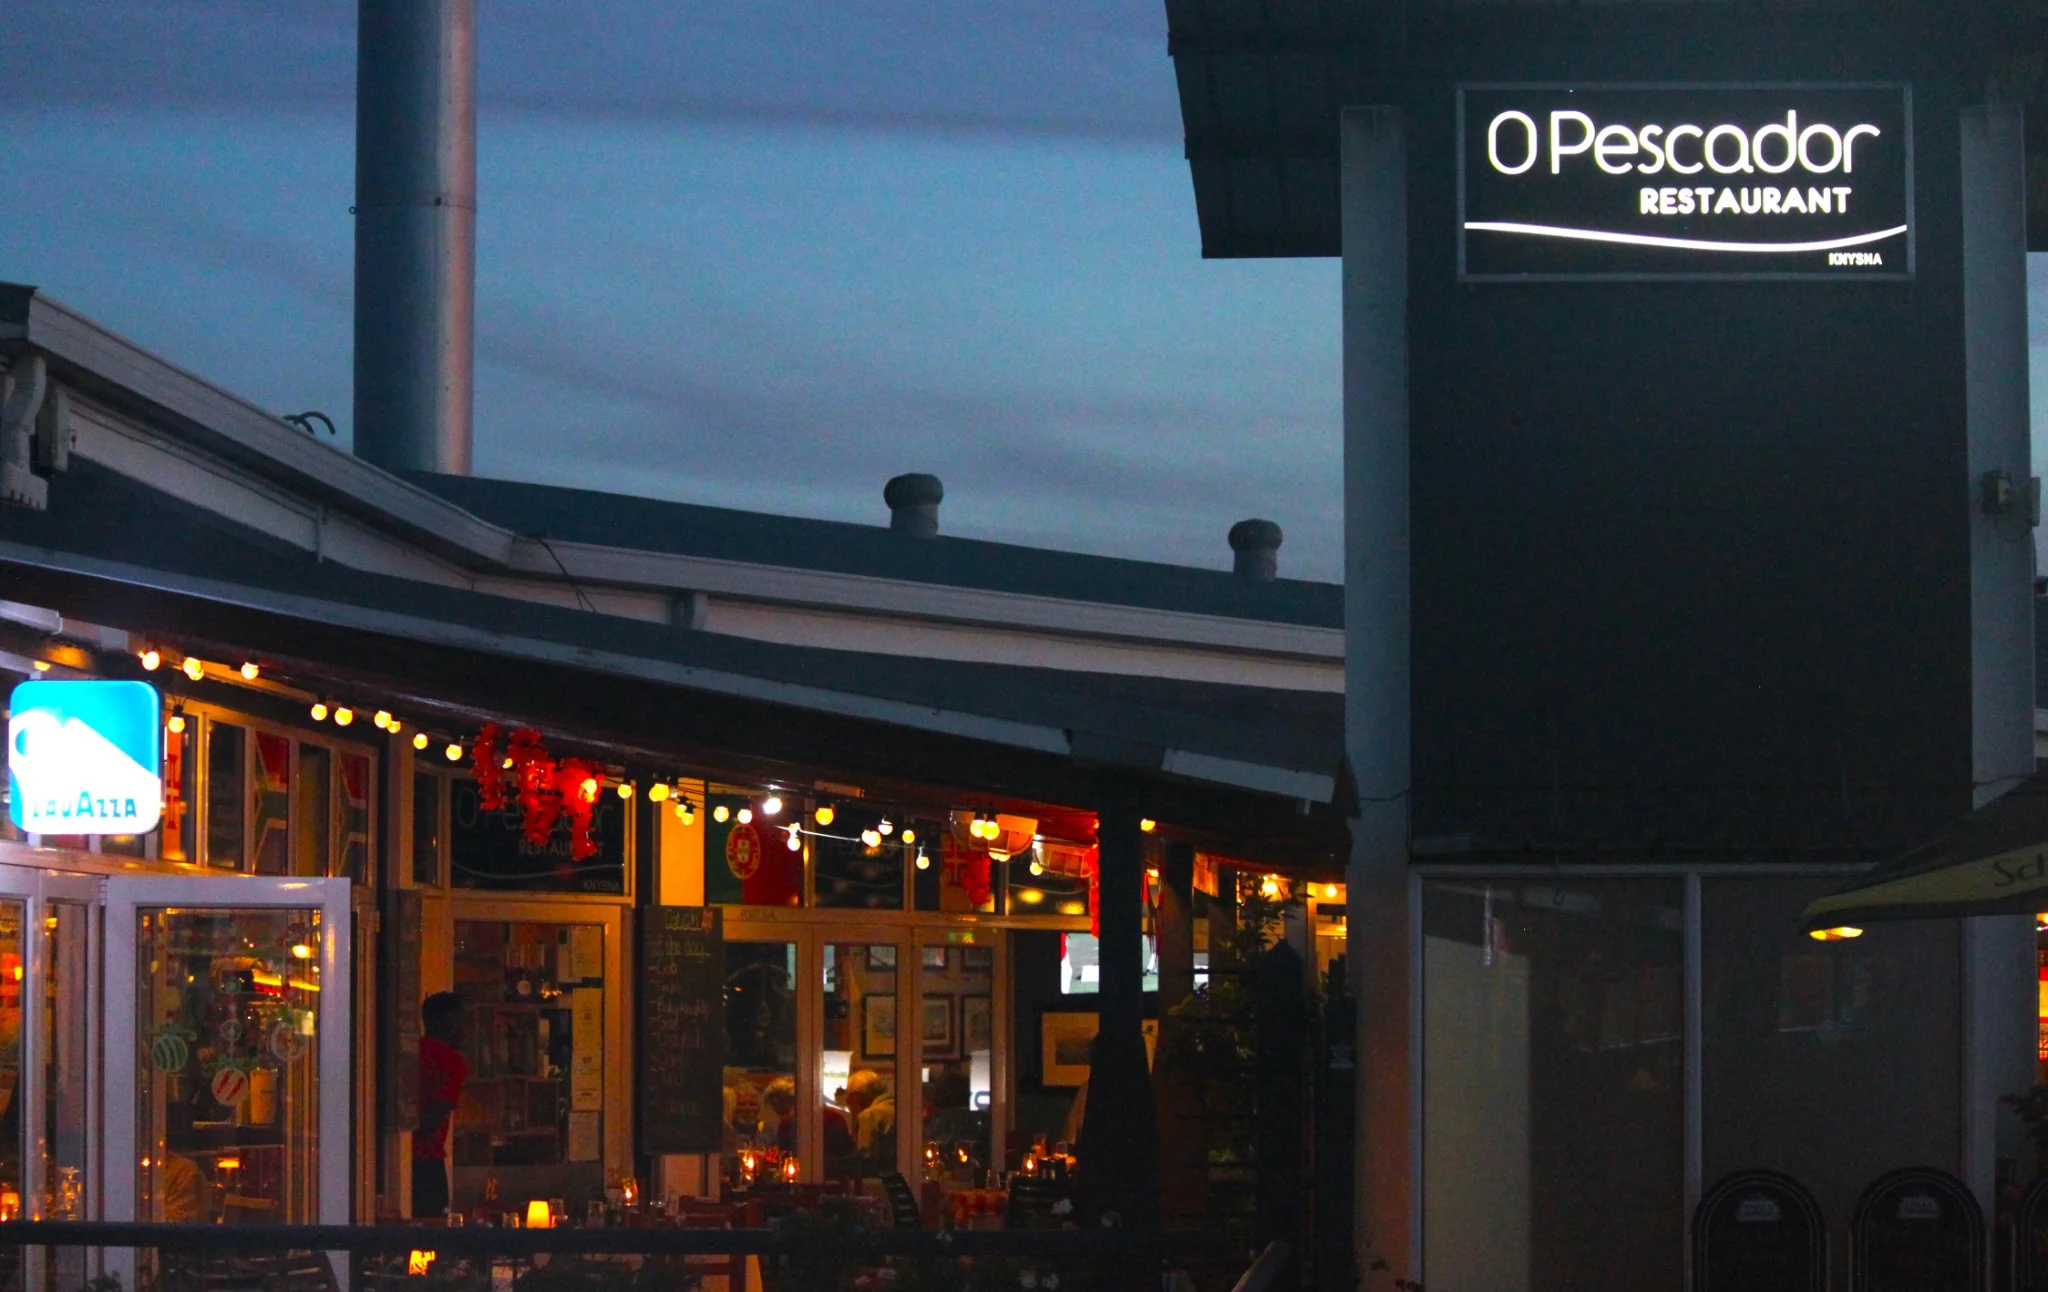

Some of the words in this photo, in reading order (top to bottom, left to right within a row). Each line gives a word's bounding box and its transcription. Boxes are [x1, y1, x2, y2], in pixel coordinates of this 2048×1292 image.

[1488, 110, 1537, 175] O
[1551, 109, 1881, 175] Pescador
[1640, 187, 1852, 214] RESTAURANT
[1829, 253, 1882, 265] KNYSNA
[518, 838, 604, 857] RESTAUT
